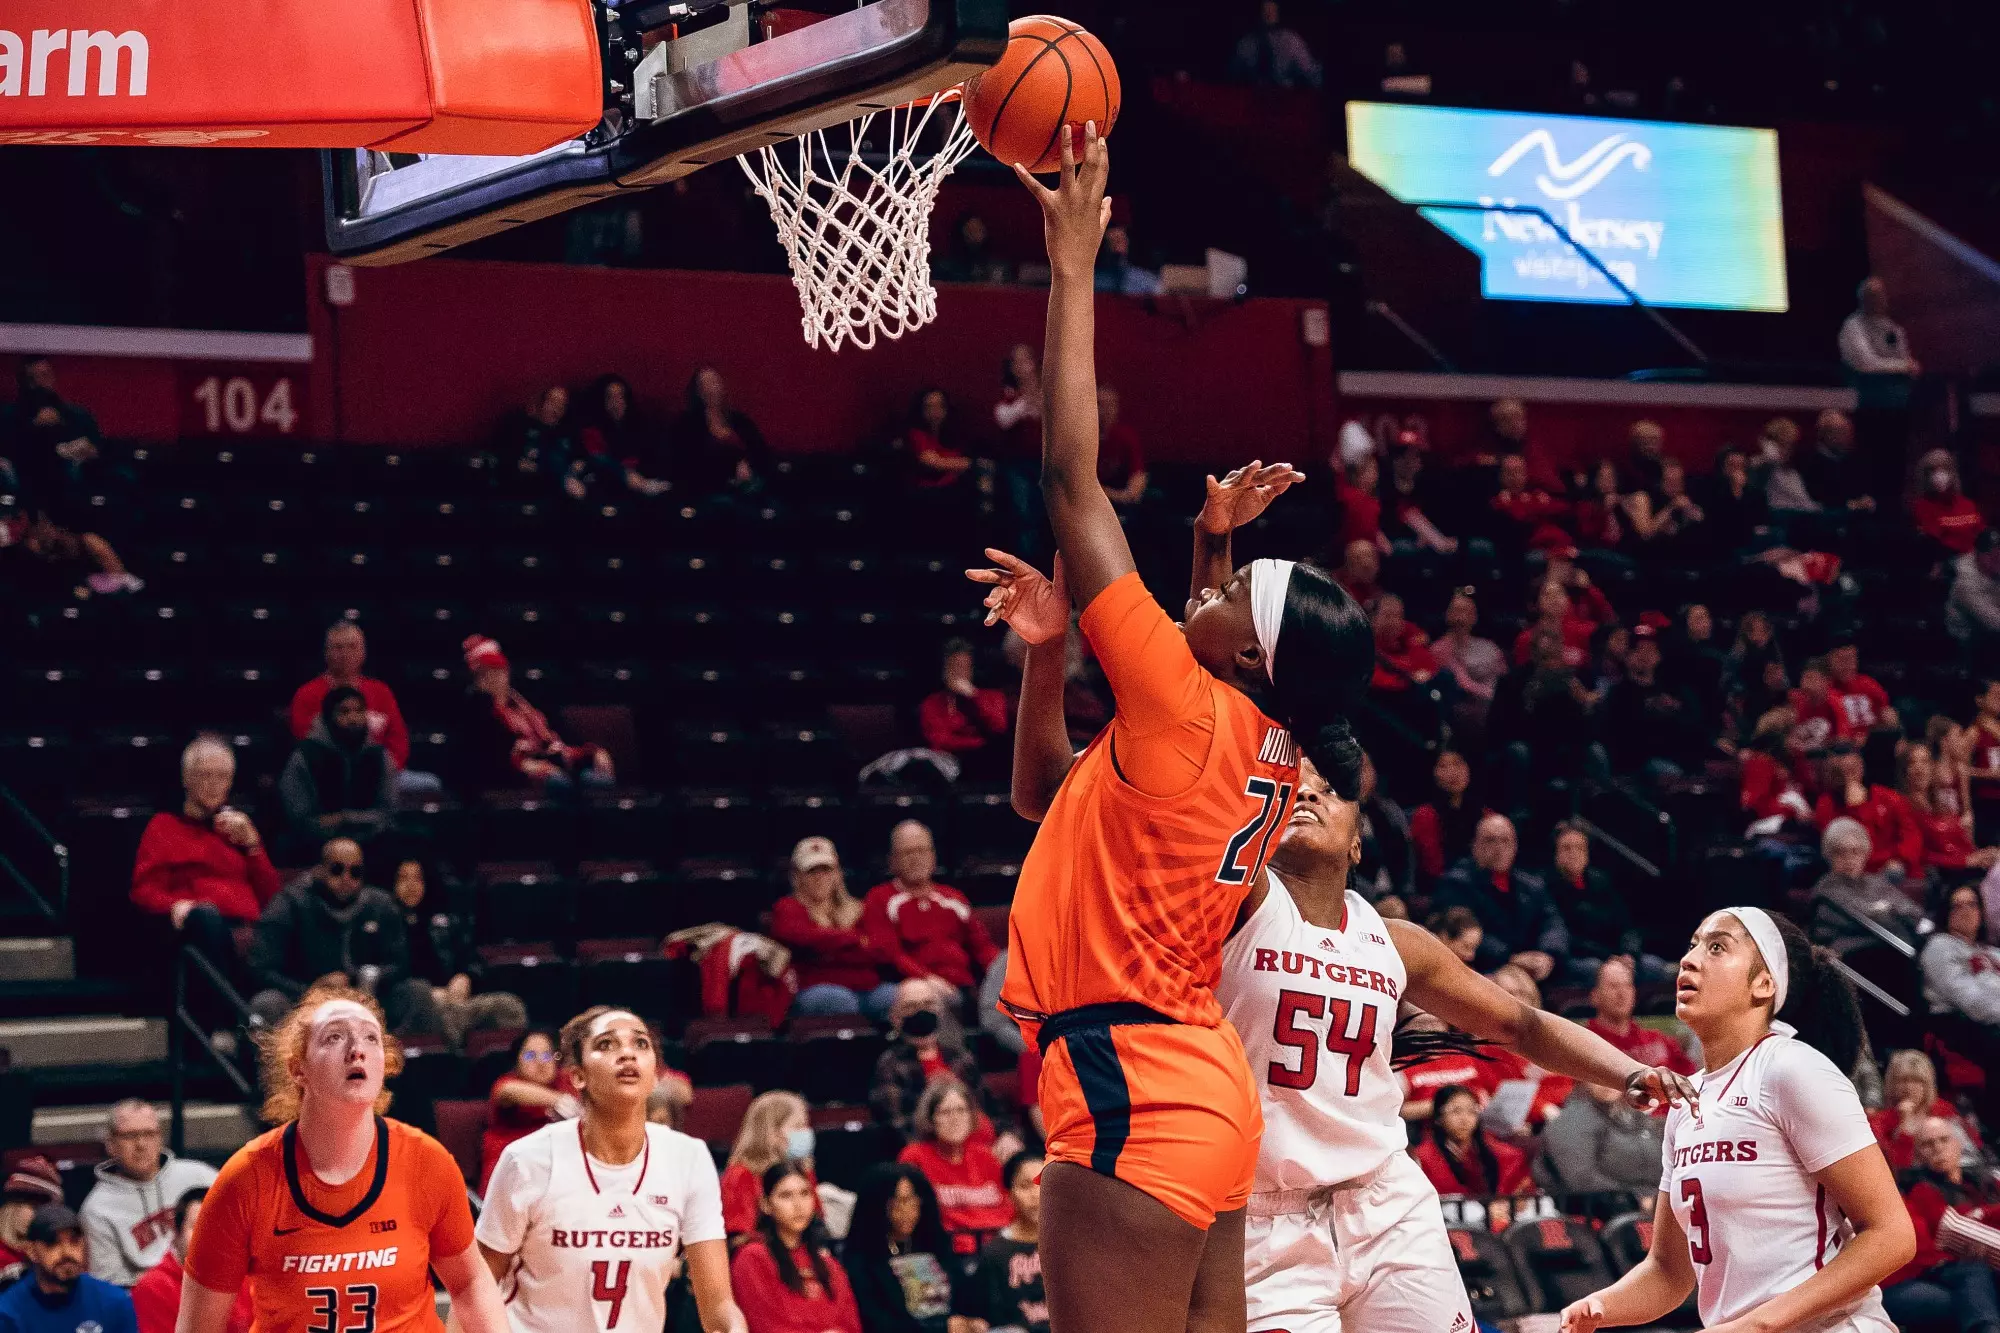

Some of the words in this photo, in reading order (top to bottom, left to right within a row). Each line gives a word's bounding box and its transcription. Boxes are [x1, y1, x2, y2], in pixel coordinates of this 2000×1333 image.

[0, 29, 149, 96] arm
[193, 376, 299, 433] 104
[1257, 726, 1297, 768] NDOU
[1215, 776, 1292, 886] 21
[1254, 948, 1398, 1001] RUTGERS
[1267, 989, 1378, 1097] 54
[1674, 1140, 1758, 1168] UTGERS
[551, 1229, 673, 1249] RUTGERS
[1681, 1178, 1713, 1266] 3
[282, 1246, 399, 1273] FIGHTING
[305, 1283, 379, 1333] 33
[591, 1260, 632, 1330] 4
